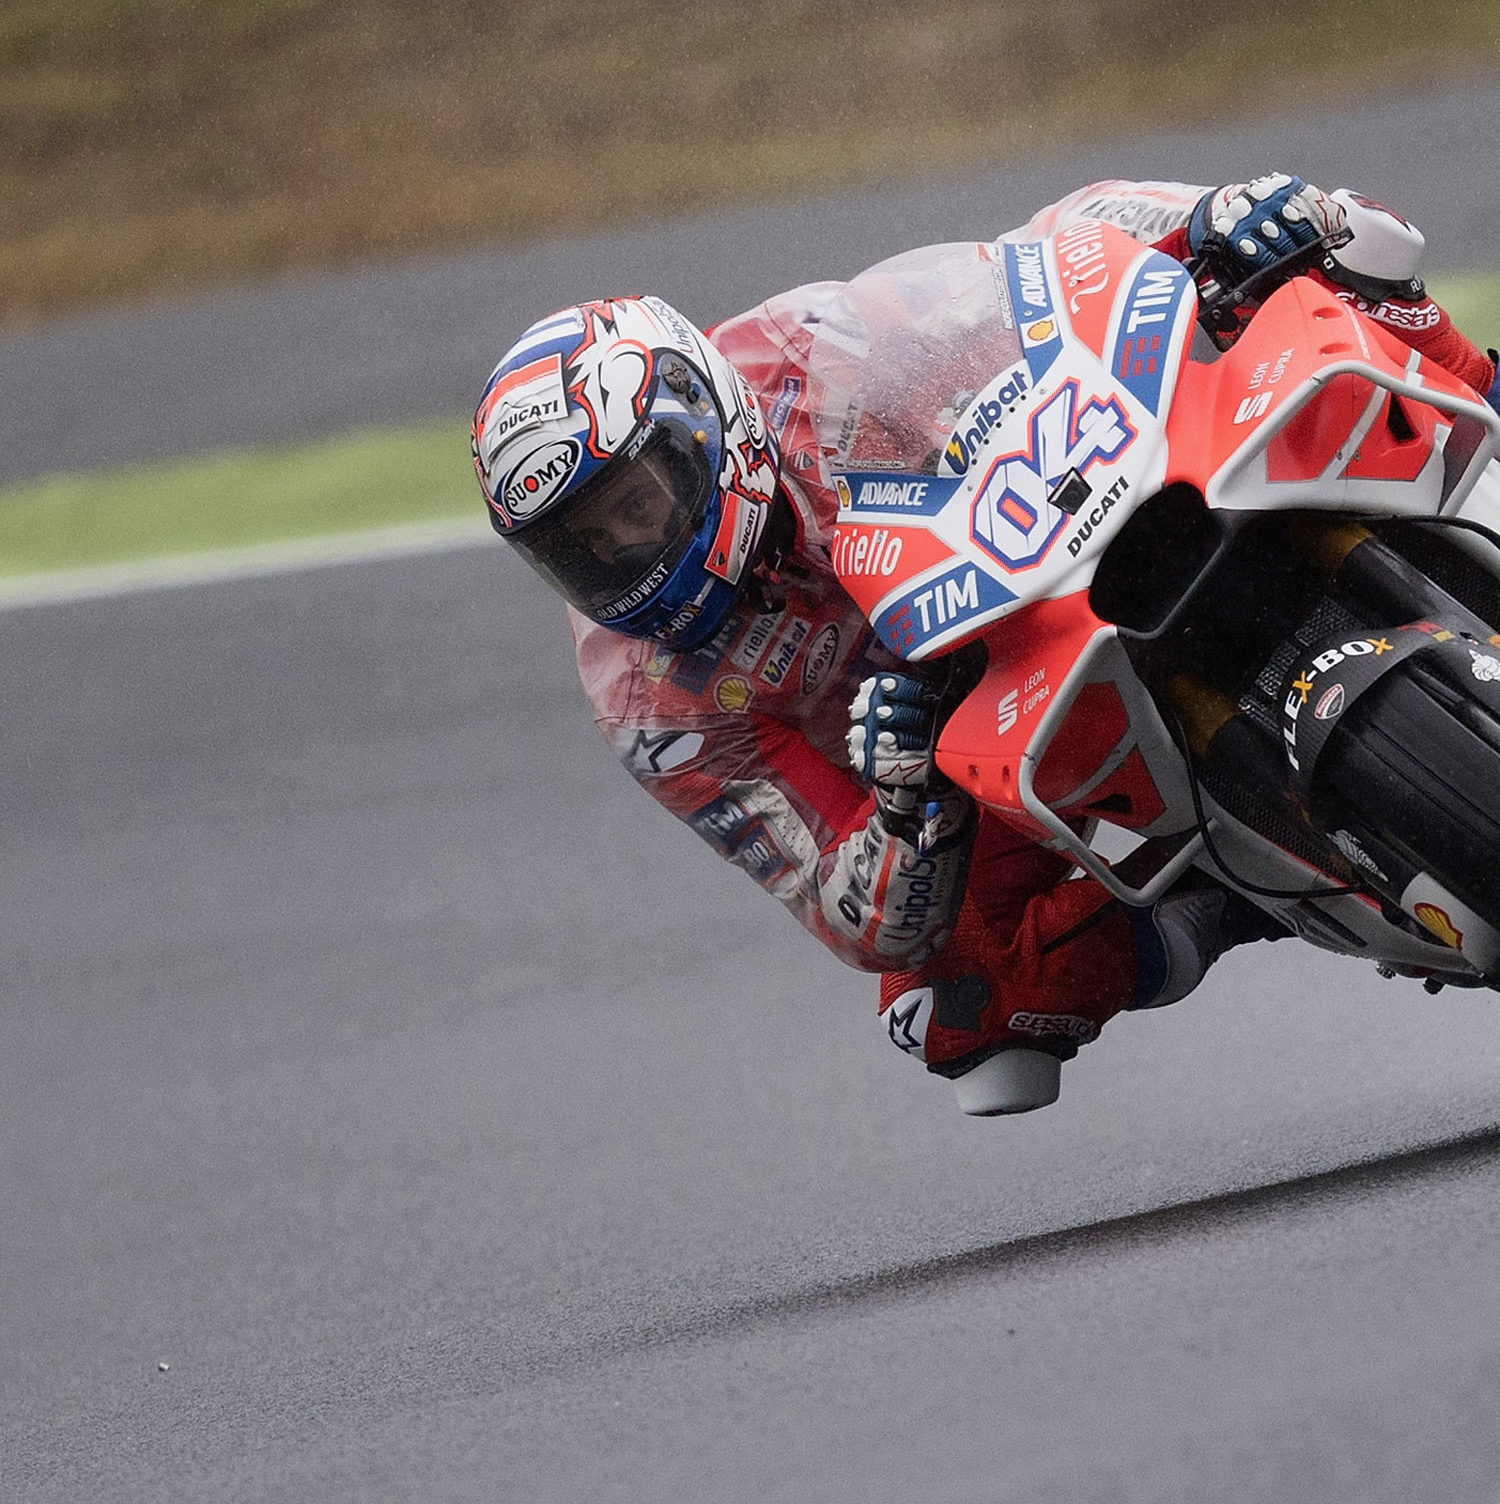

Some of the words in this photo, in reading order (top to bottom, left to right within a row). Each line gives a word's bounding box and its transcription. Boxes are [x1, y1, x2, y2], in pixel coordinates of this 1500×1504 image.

[1014, 244, 1048, 308] ADVANCE
[1126, 270, 1184, 334] TIM
[1248, 362, 1271, 390] LEON
[1268, 347, 1295, 384] CUPRA
[499, 400, 559, 435] DUCATI
[944, 371, 1028, 476] Unibat
[504, 450, 574, 508] SUOMY
[857, 481, 929, 506] ADVANCE
[969, 376, 1139, 576] 04
[739, 508, 757, 554] DUCATI
[1066, 476, 1130, 558] DUCATI
[614, 590, 643, 613] WILD
[638, 562, 669, 597] WEST
[913, 569, 979, 633] TIM
[1023, 684, 1050, 715] CUPRA
[1024, 667, 1046, 694] LEON
